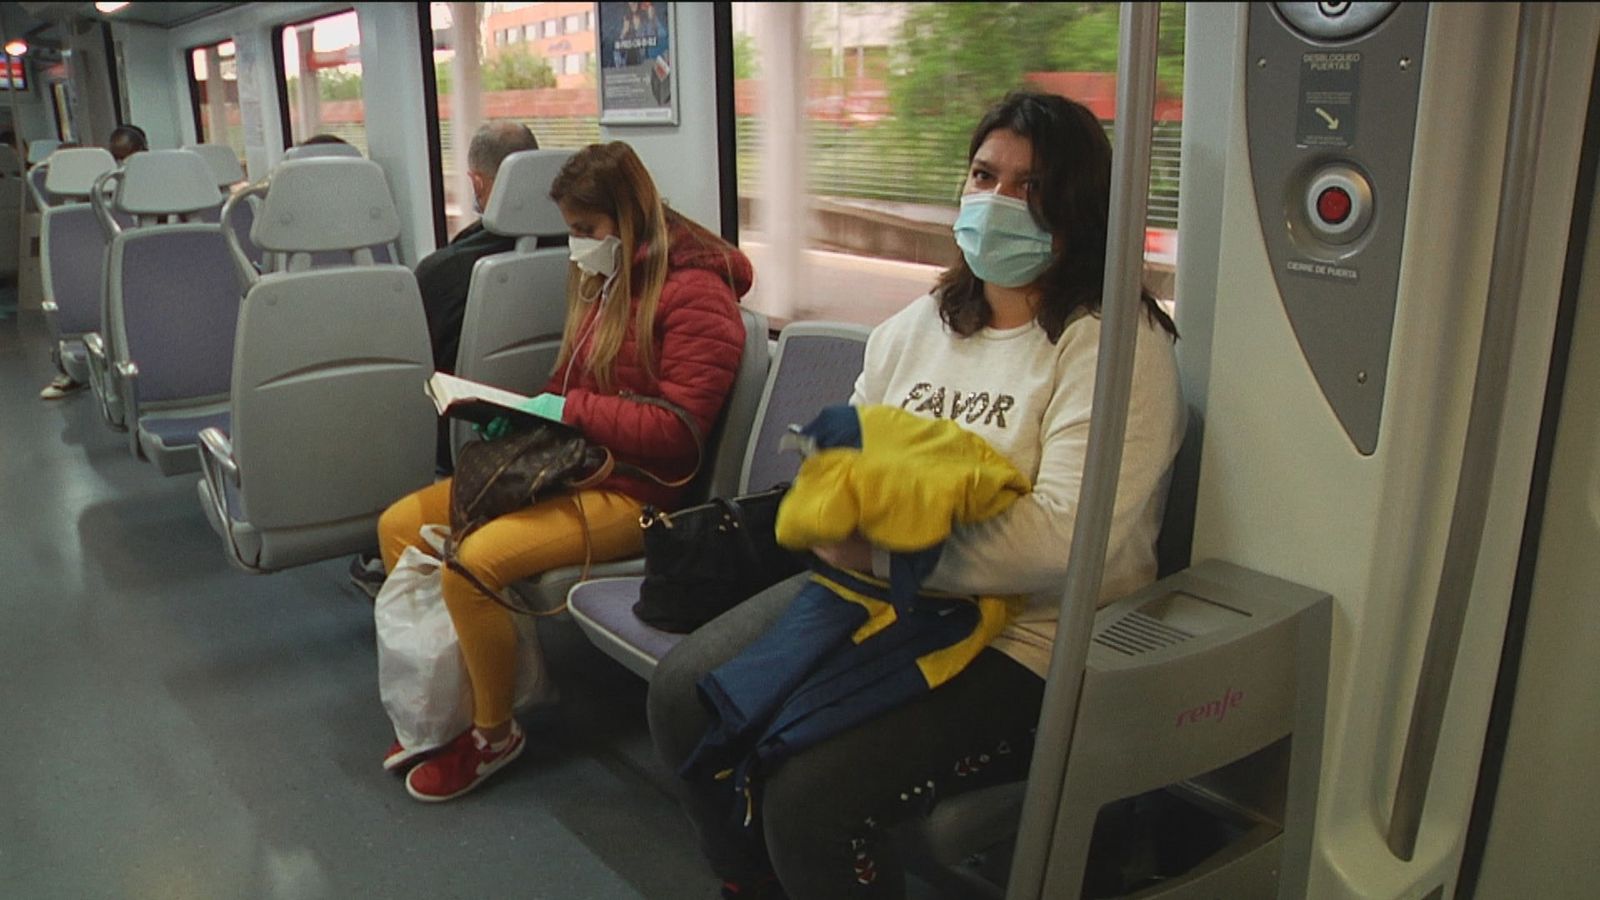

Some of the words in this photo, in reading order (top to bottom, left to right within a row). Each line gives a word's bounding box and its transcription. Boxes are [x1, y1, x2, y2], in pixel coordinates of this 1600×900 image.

[1303, 53, 1360, 62] DESBLOQUEO
[1311, 62, 1351, 71] PUERTAS
[1287, 261, 1314, 272] CIERRE
[1315, 265, 1325, 274] DE
[1327, 266, 1357, 278] PUERTA
[901, 382, 1015, 428] FAVOR
[1176, 688, 1244, 729] renfe
